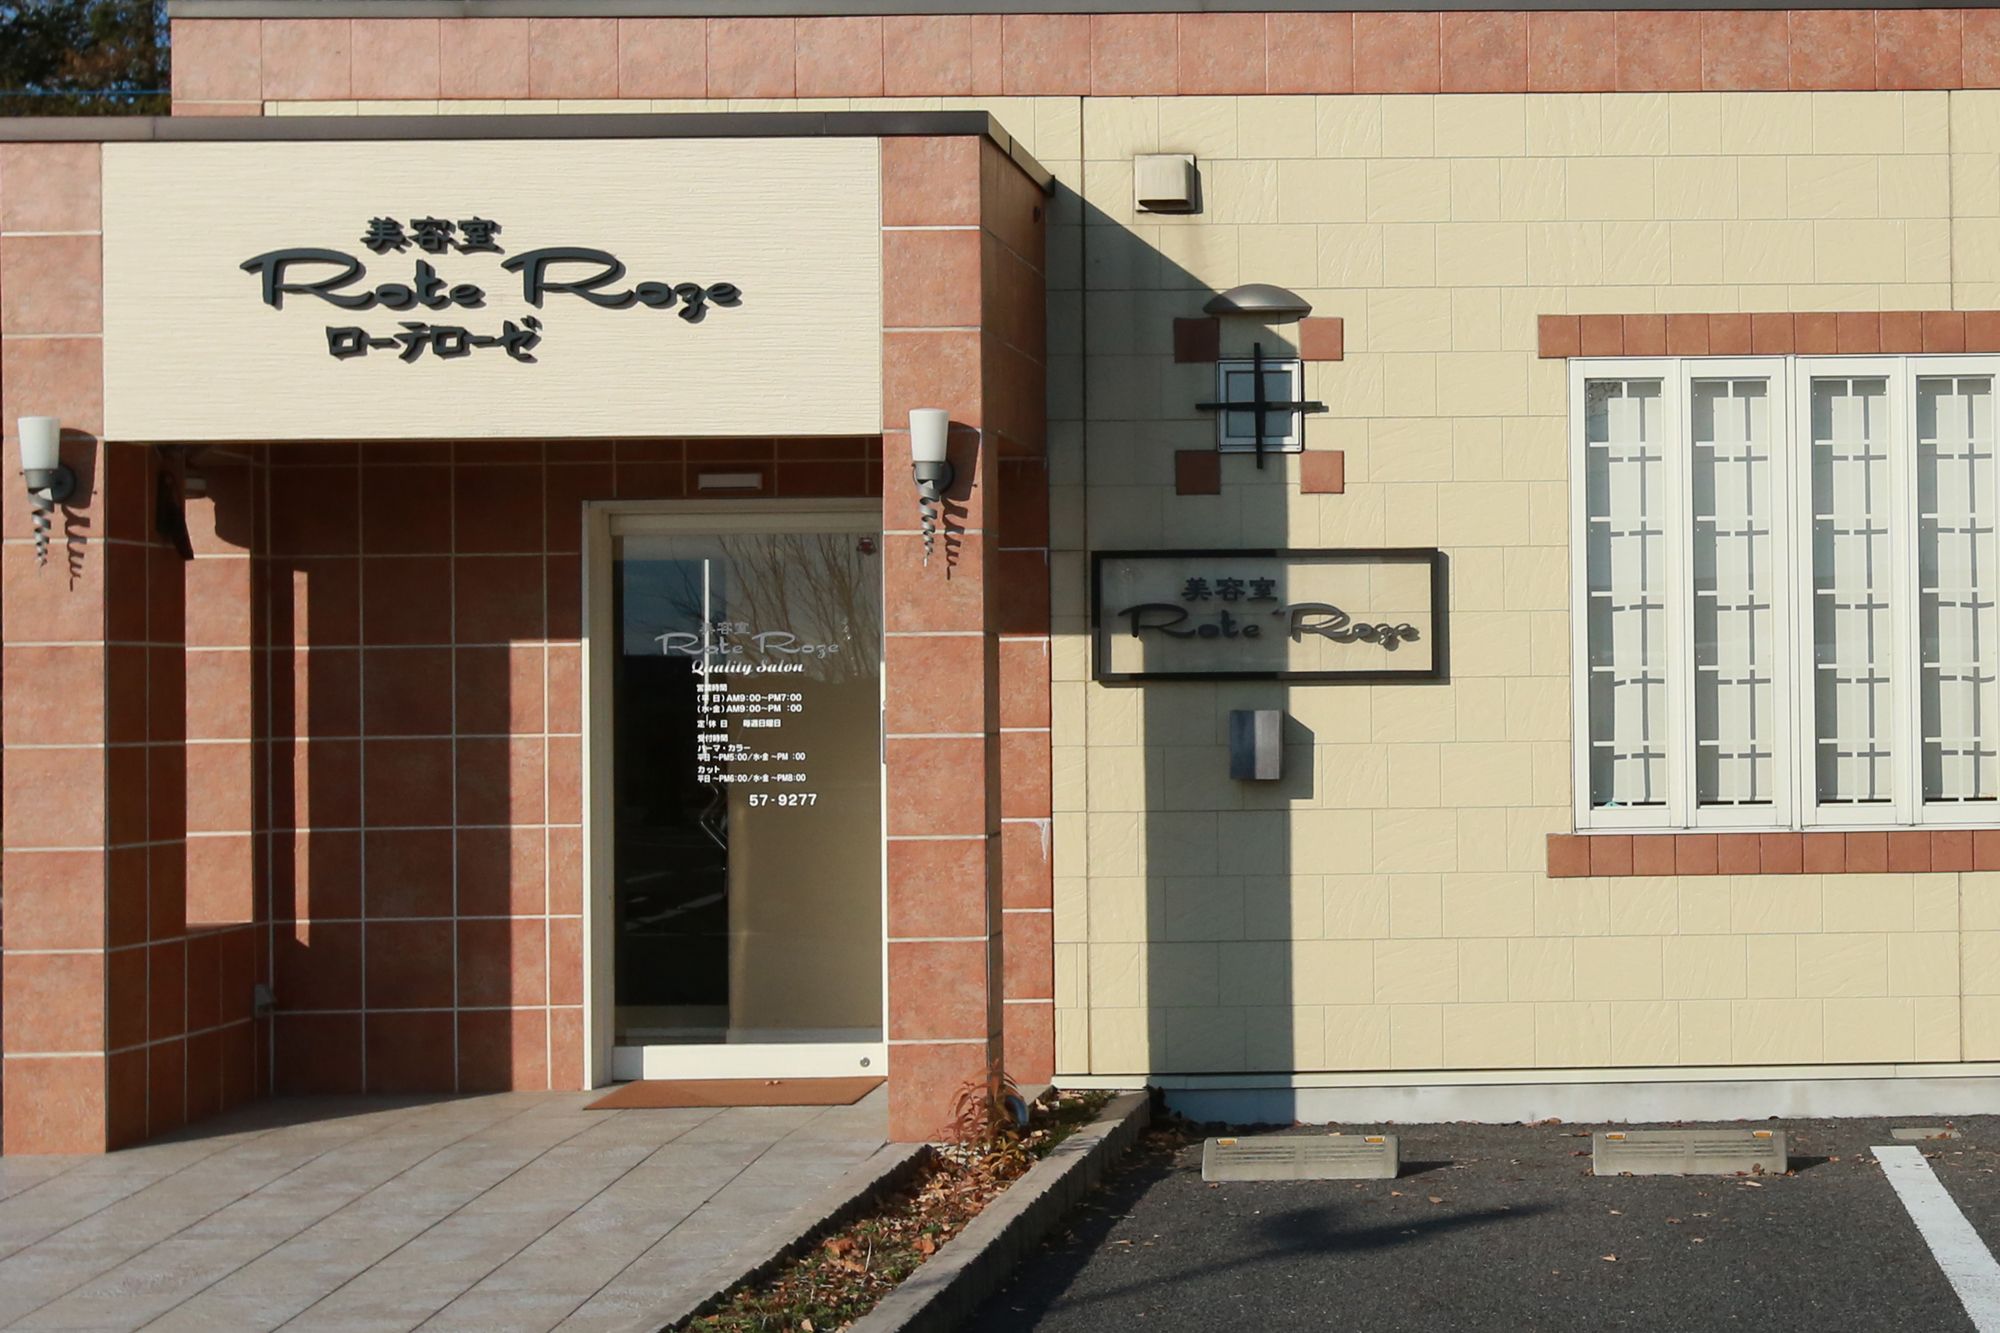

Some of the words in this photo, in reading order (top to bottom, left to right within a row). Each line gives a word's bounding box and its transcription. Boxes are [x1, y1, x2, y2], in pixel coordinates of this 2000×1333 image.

[360, 216, 504, 254] 美容室
[1181, 577, 1278, 601] 美容室
[691, 659, 754, 676] Quality
[756, 658, 805, 673] Salon
[697, 765, 720, 774] カット
[749, 793, 817, 807] 57-9277
